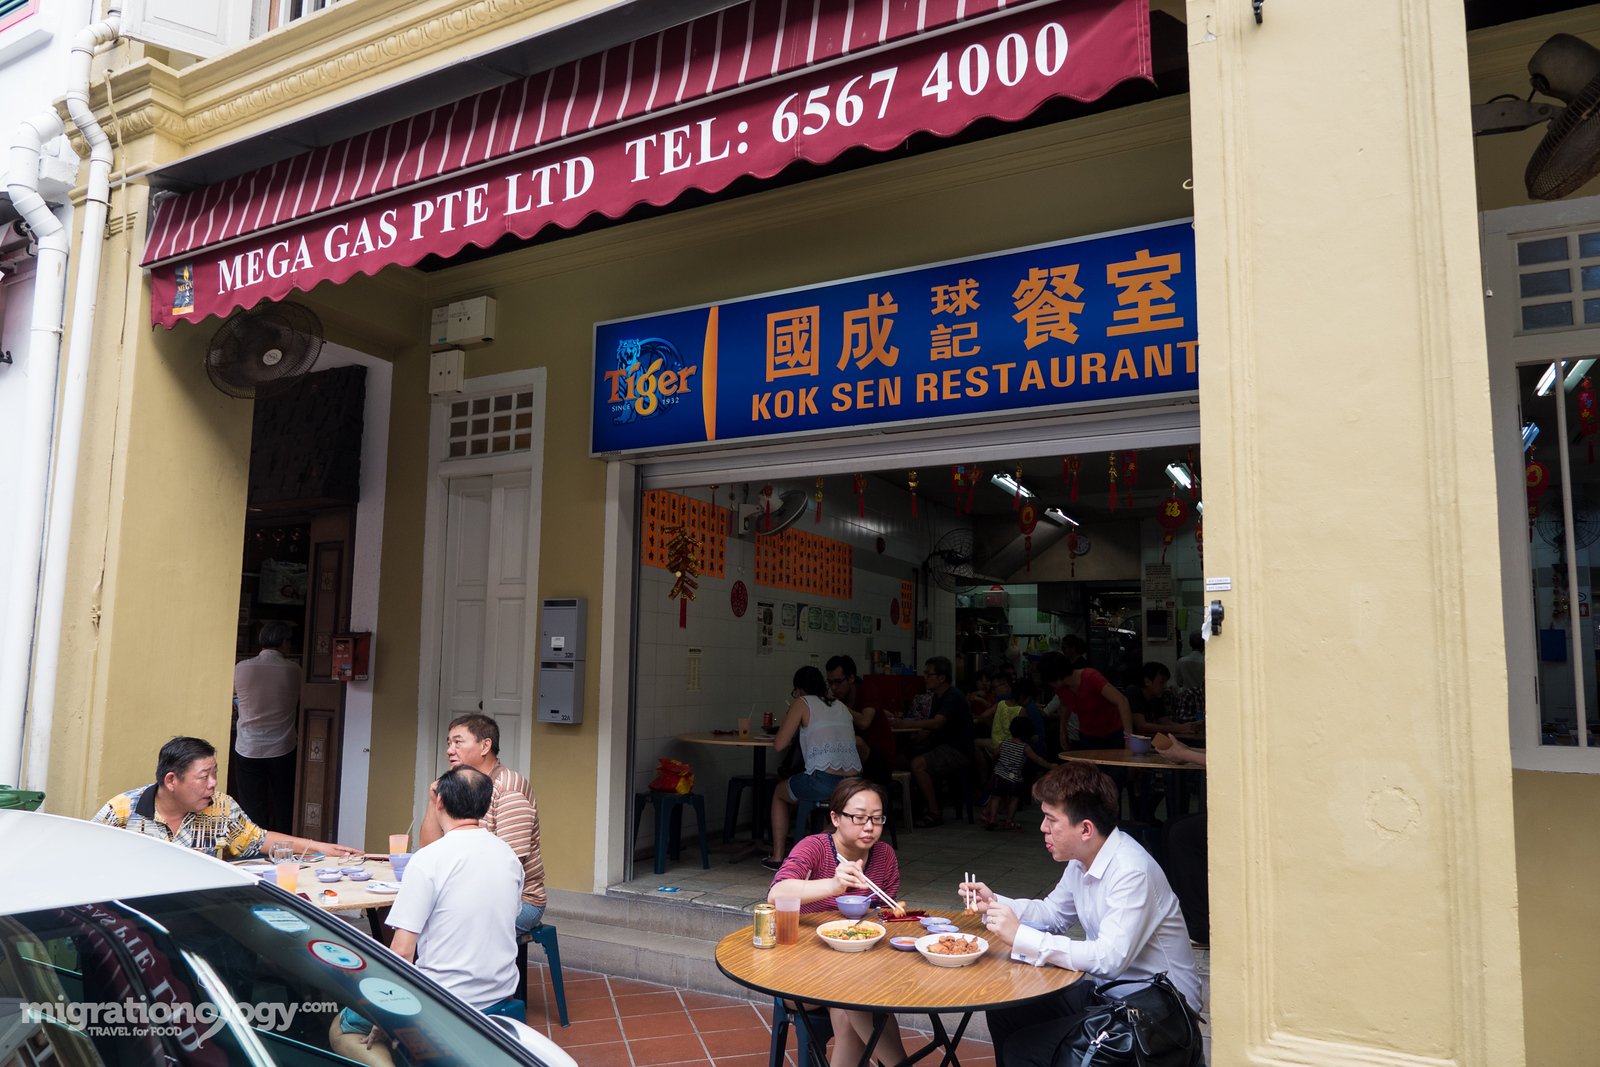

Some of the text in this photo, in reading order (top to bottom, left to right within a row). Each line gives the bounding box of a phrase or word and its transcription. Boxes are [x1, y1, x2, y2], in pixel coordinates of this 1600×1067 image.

[218, 22, 1069, 294] MEGA GAS PTE LTD TEL: 6567 4000
[604, 358, 697, 415] Tiger
[612, 396, 680, 412] SINCE 1932
[751, 340, 1199, 421] KOK SEN RESTAURANT
